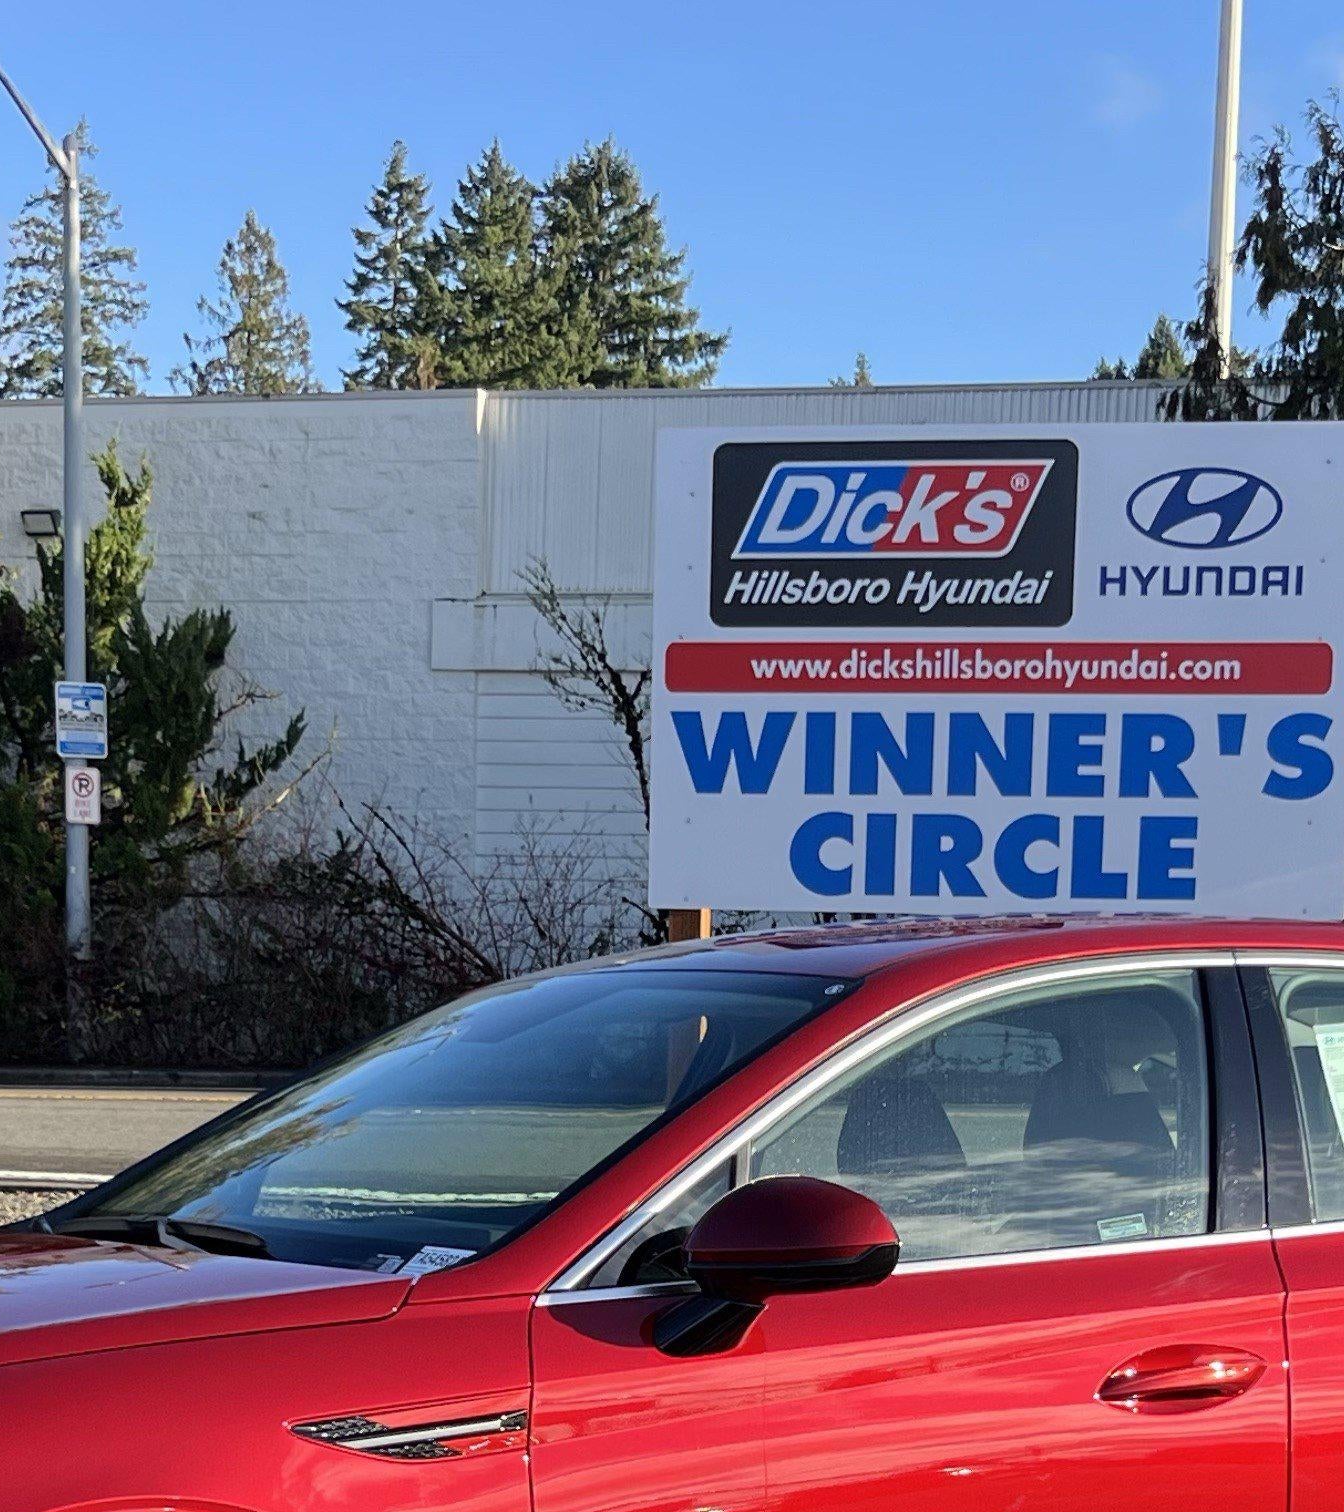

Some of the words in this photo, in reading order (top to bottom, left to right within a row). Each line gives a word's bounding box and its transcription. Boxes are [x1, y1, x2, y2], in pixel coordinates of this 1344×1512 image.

[724, 570, 892, 605] Hillsboro
[896, 570, 1054, 613] Hyundai
[1099, 565, 1304, 597] HYUNDAI
[751, 650, 1241, 688] www.dickshillsborohyundai.com
[670, 711, 1336, 801] WINNER'S
[788, 811, 1199, 901] CIRCLE
